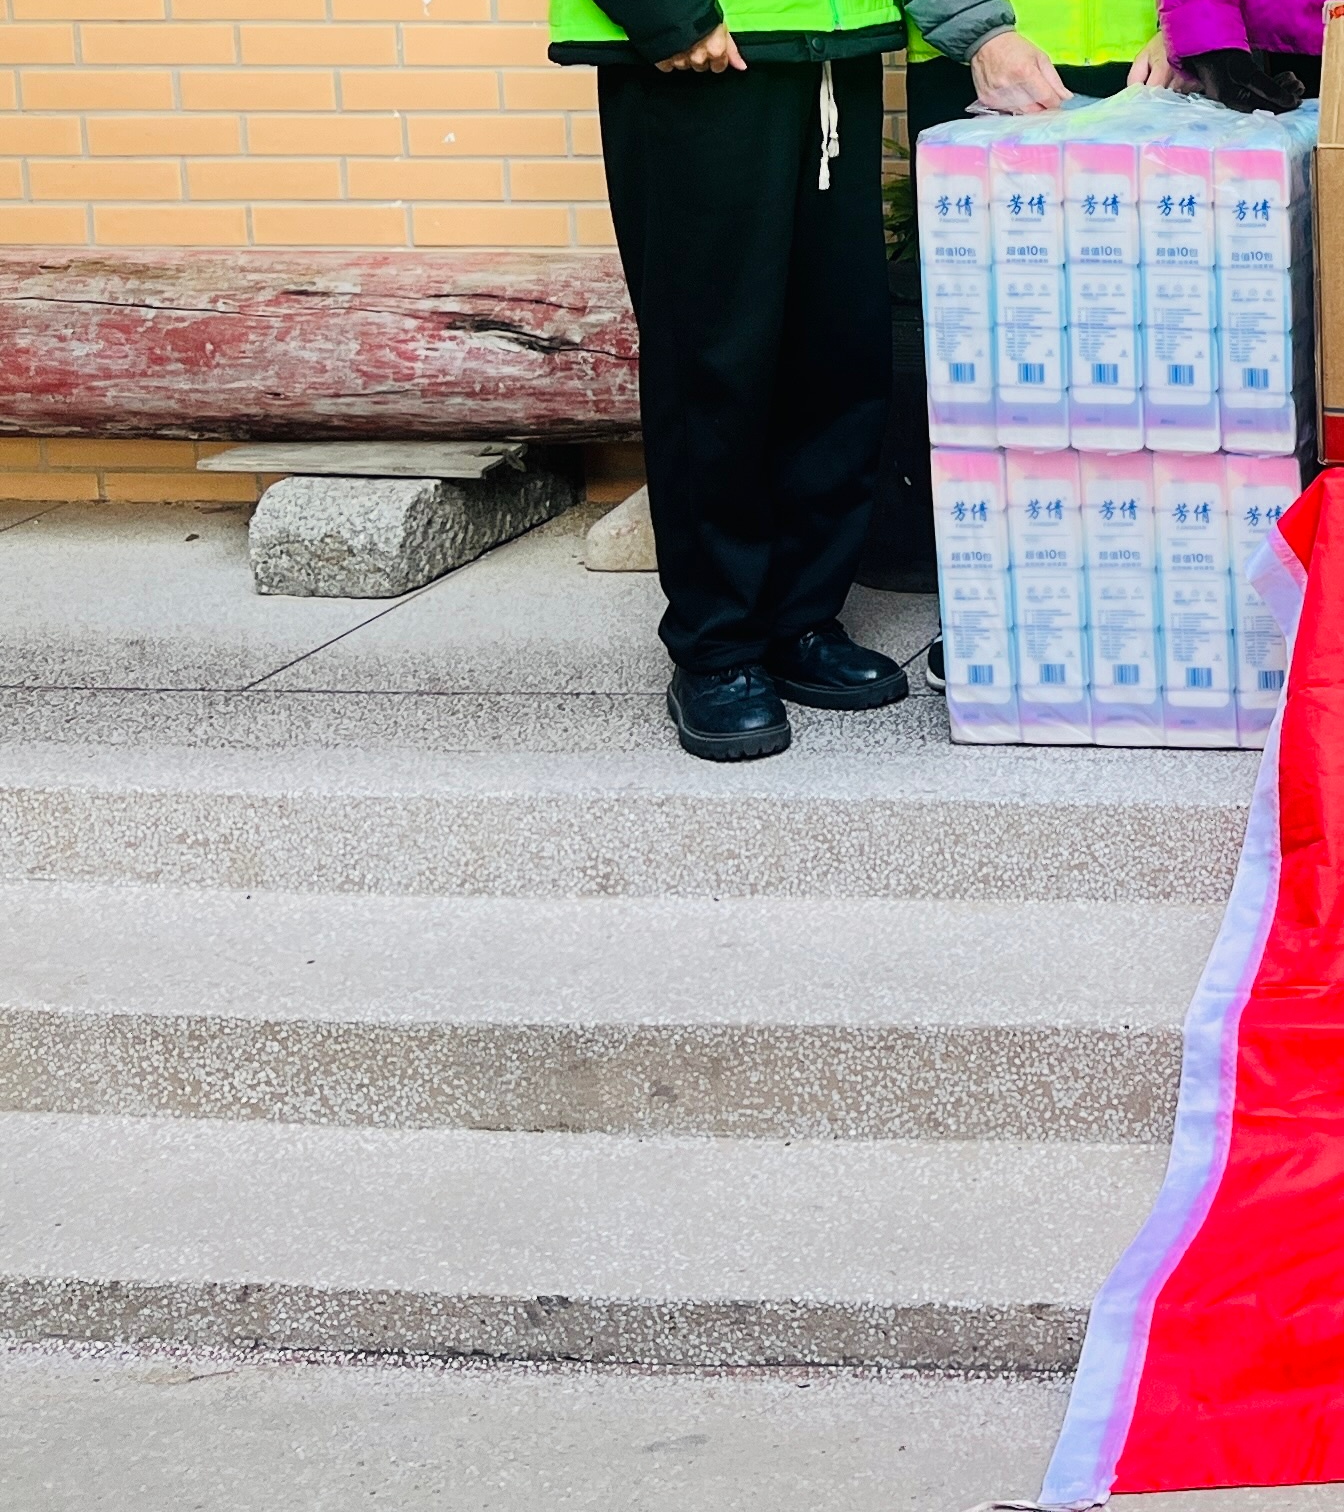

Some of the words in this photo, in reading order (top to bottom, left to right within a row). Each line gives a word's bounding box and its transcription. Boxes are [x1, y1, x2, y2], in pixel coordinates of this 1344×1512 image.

[934, 193, 974, 217] 芳倩
[1006, 193, 1048, 217] 芳倩
[1080, 193, 1121, 217] 芳倩
[1157, 194, 1198, 217] 芳倩
[1232, 198, 1271, 222] 芳倩
[950, 500, 989, 523] 芳倩
[1024, 498, 1063, 522] 芳倩
[1098, 498, 1138, 522] 芳倩
[1172, 501, 1212, 525] 芳倩
